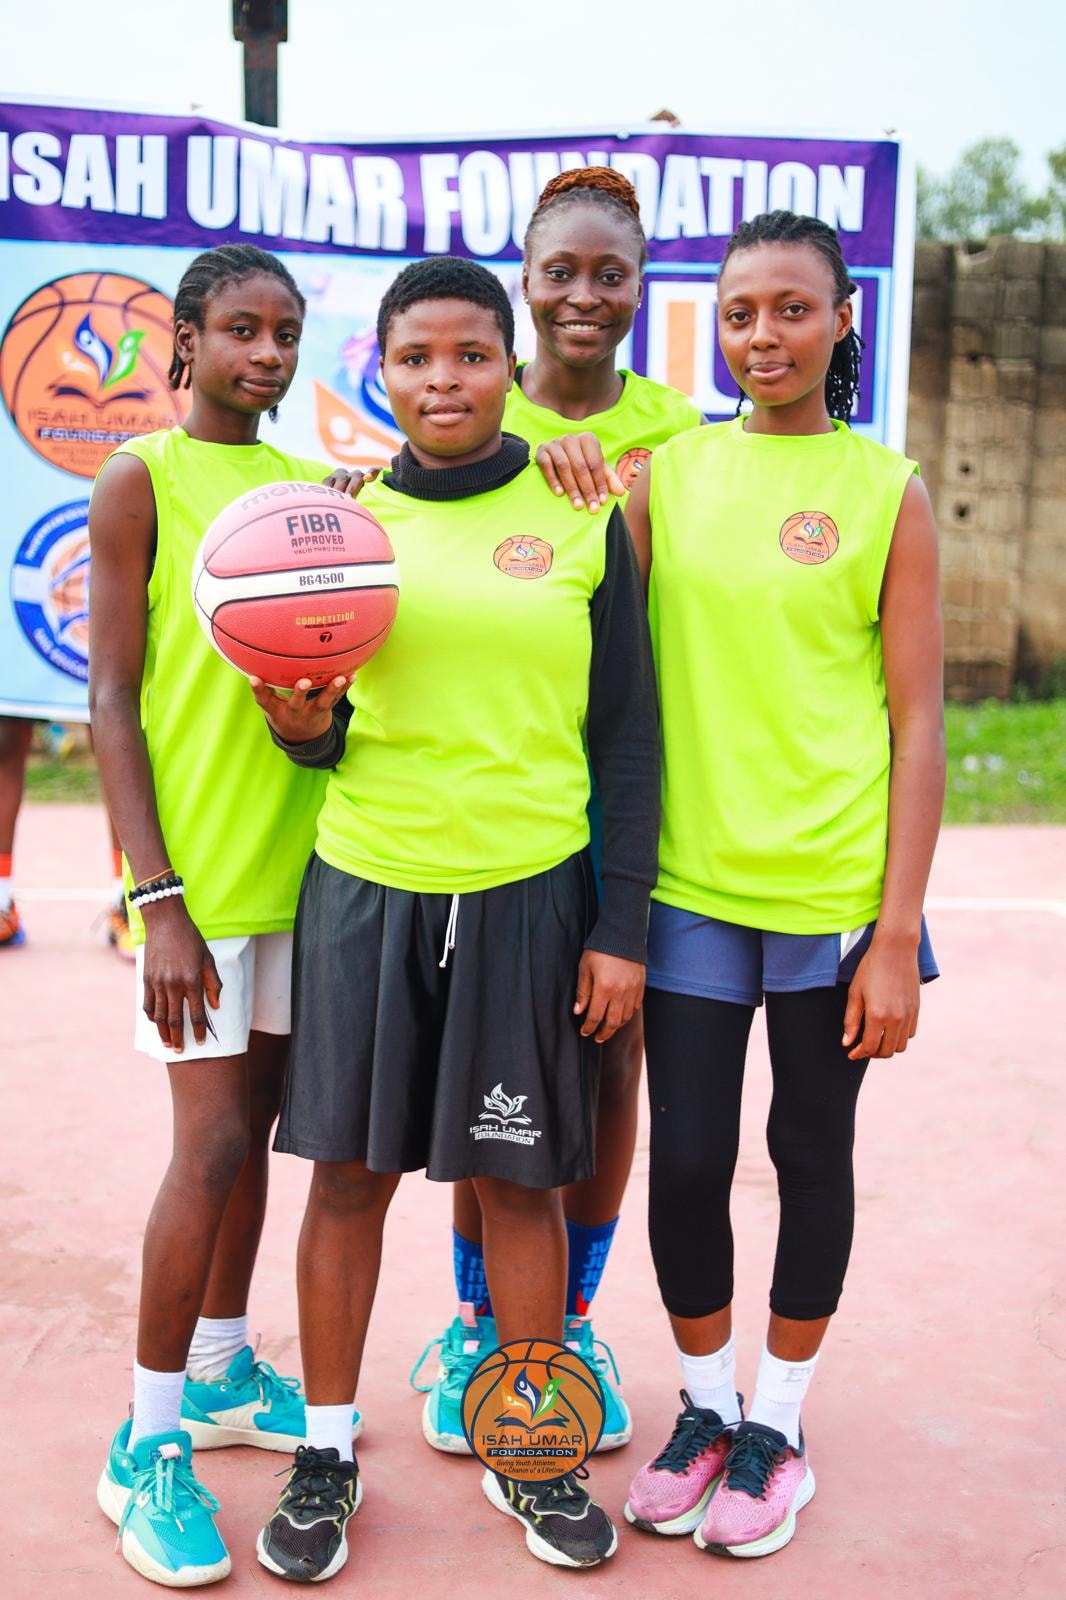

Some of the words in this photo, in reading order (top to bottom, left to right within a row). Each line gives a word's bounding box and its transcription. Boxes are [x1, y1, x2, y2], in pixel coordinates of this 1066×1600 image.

[186, 134, 407, 252] UMAR
[420, 150, 866, 257] FOUDATION
[241, 483, 345, 511] molten
[286, 513, 342, 536] FIBA
[291, 535, 344, 548] APPROVED
[299, 572, 345, 586] BG4500
[295, 611, 355, 625] COMPETITION
[469, 1124, 499, 1134] ISAH
[502, 1126, 542, 1138] UMAR
[476, 1131, 532, 1144] FOUNDATION
